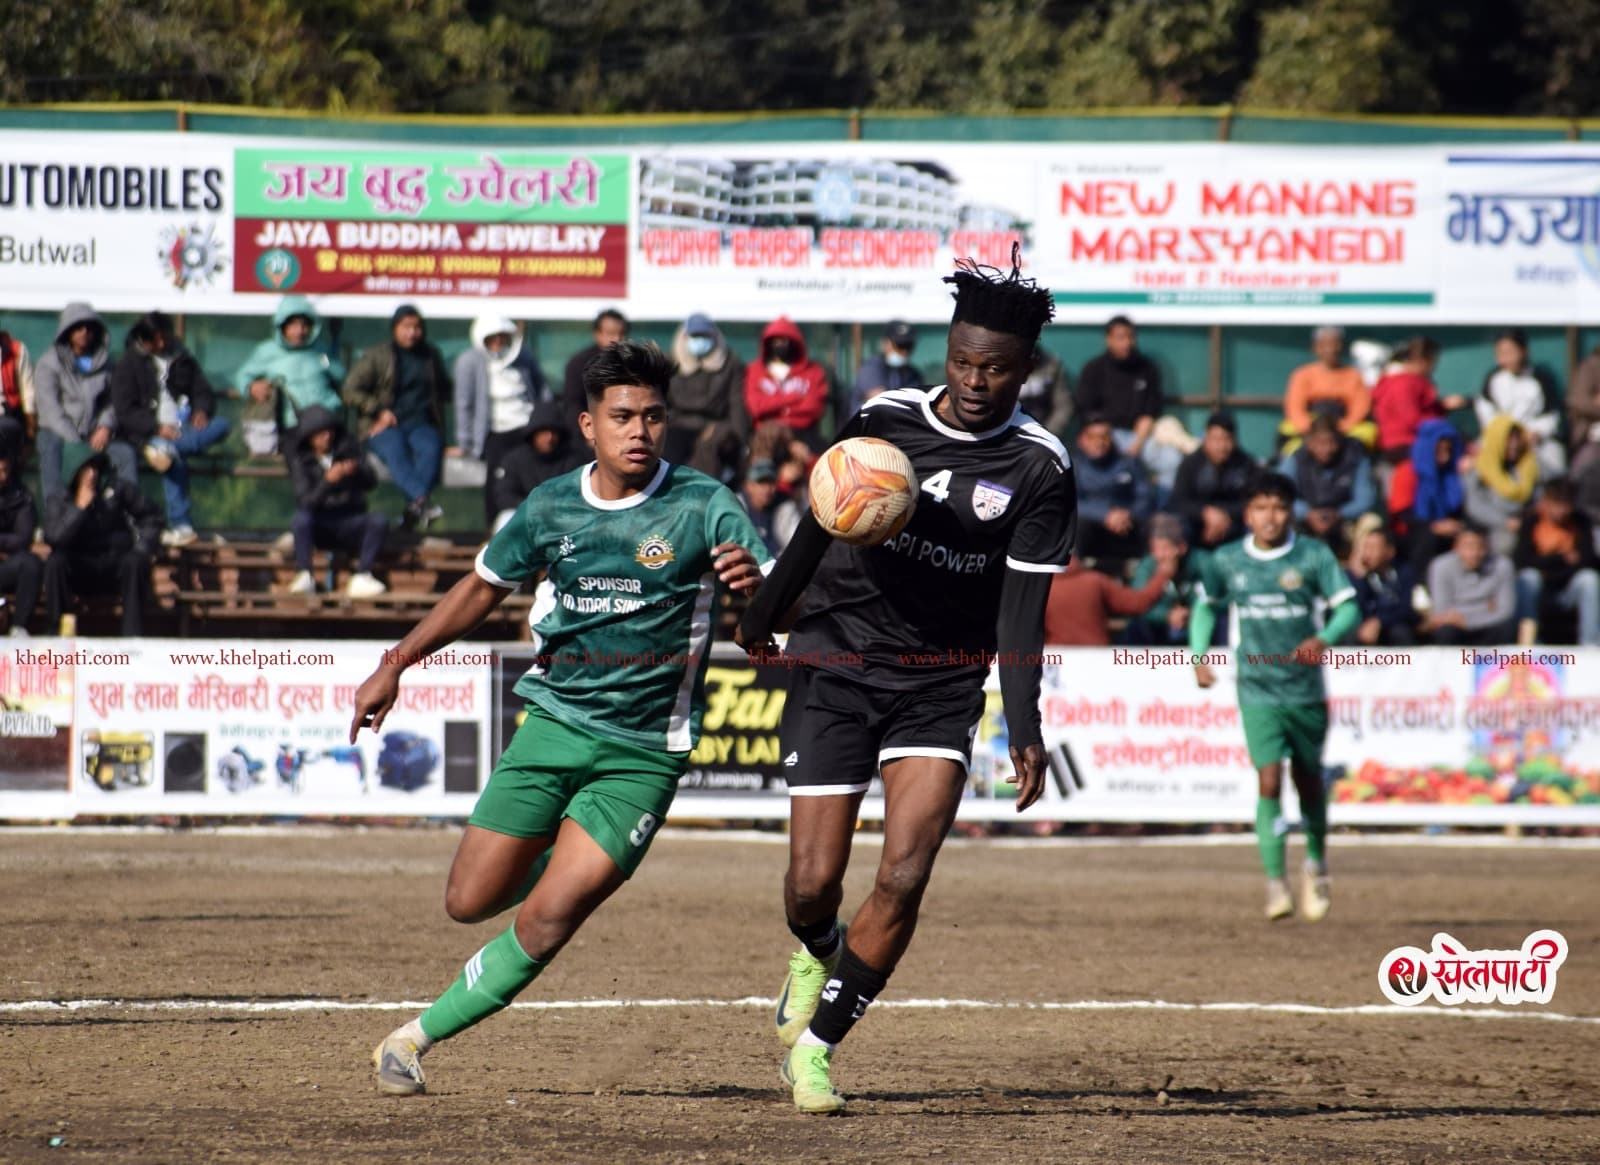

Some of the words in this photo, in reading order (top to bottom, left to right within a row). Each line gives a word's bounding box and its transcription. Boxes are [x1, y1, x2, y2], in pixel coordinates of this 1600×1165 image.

[264, 163, 348, 201] जय
[446, 154, 603, 207] ज्वेलरी
[1060, 180, 1176, 217] NEW
[1201, 180, 1417, 218] MANANG
[0, 235, 96, 264] Butwal
[257, 221, 331, 247] JAYA
[339, 223, 462, 249] BUDDHA
[468, 225, 606, 251] JEWELRY
[822, 229, 938, 268] SECONDARY
[1070, 227, 1406, 264] MARSYANGDI
[921, 469, 953, 503] 4
[918, 540, 987, 574] POWER
[578, 576, 642, 594] SPONSOR
[630, 812, 656, 847] 9
